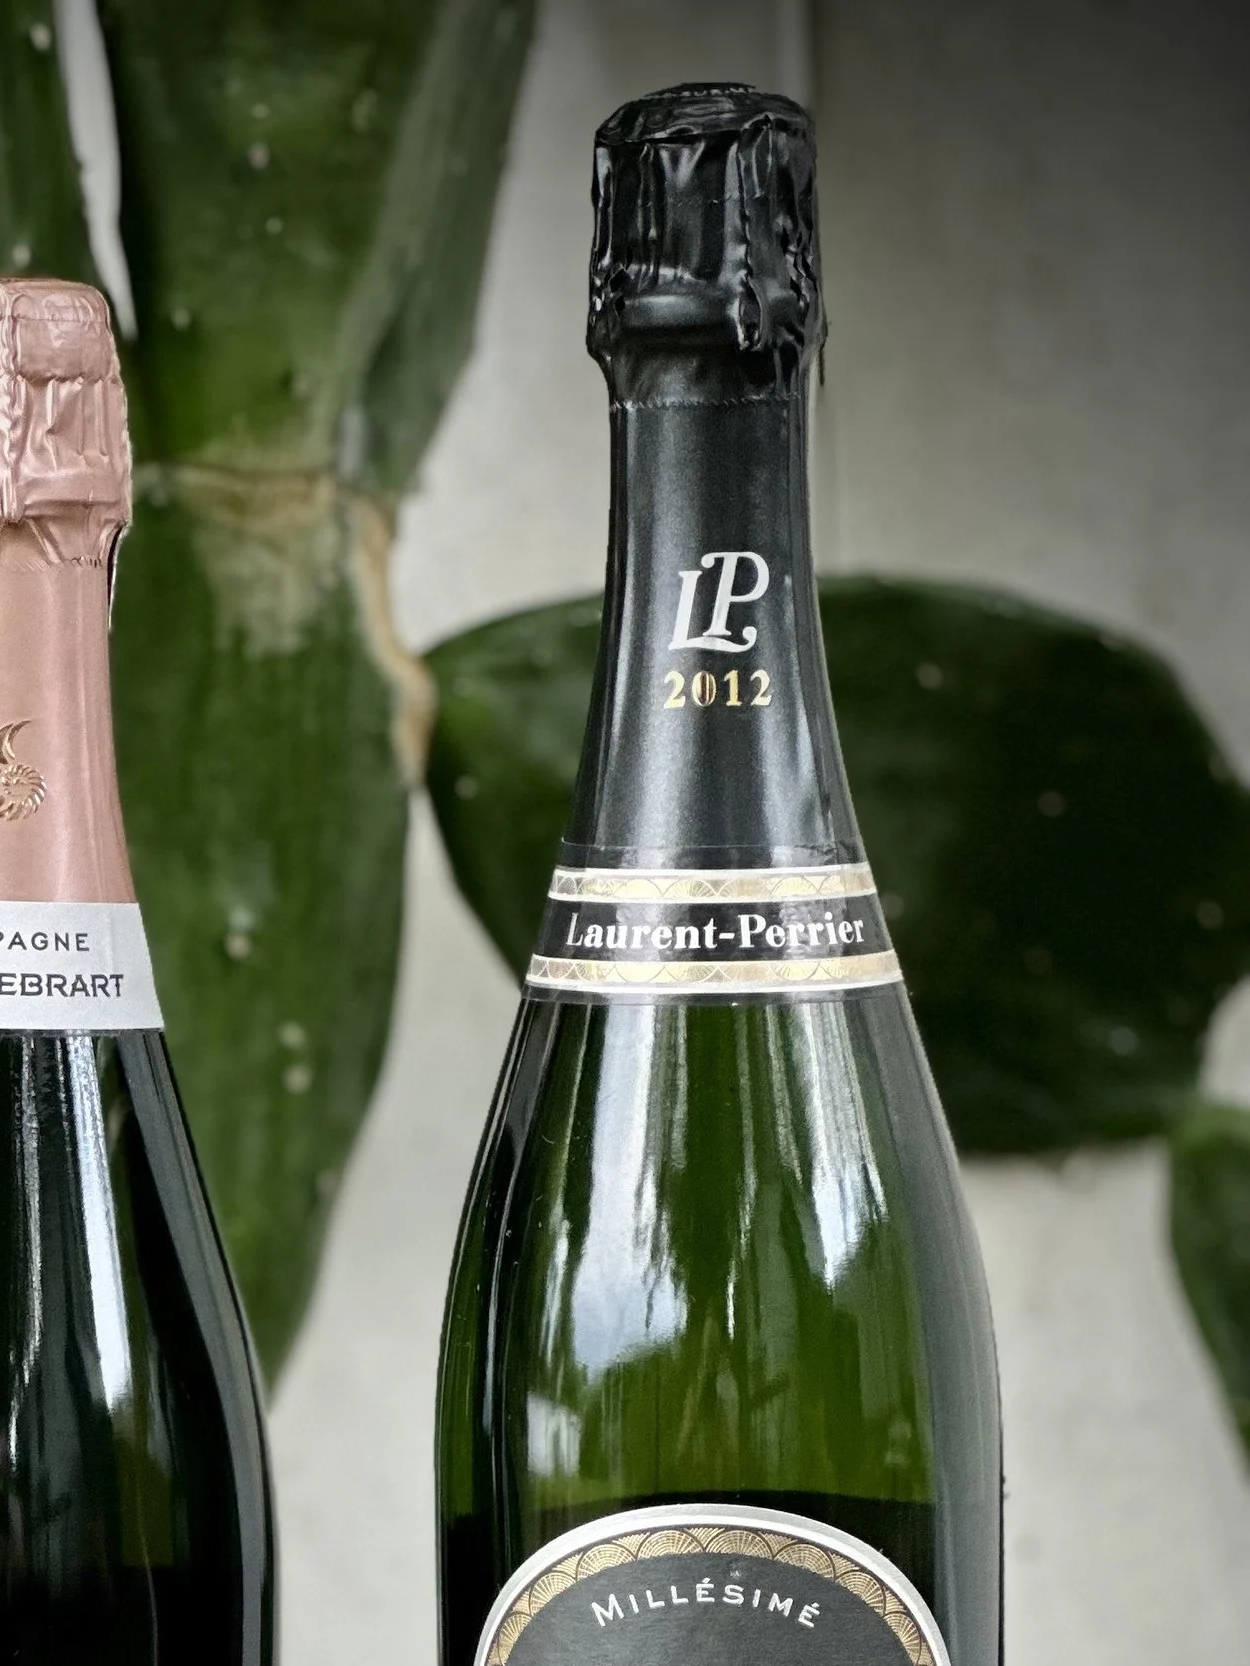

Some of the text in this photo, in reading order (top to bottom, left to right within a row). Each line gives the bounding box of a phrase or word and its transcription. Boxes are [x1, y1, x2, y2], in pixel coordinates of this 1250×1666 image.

[663, 668, 772, 709] 2012
[565, 911, 866, 951] Laurent-Perrier
[591, 1576, 822, 1629] MILLÉSIMÉ
